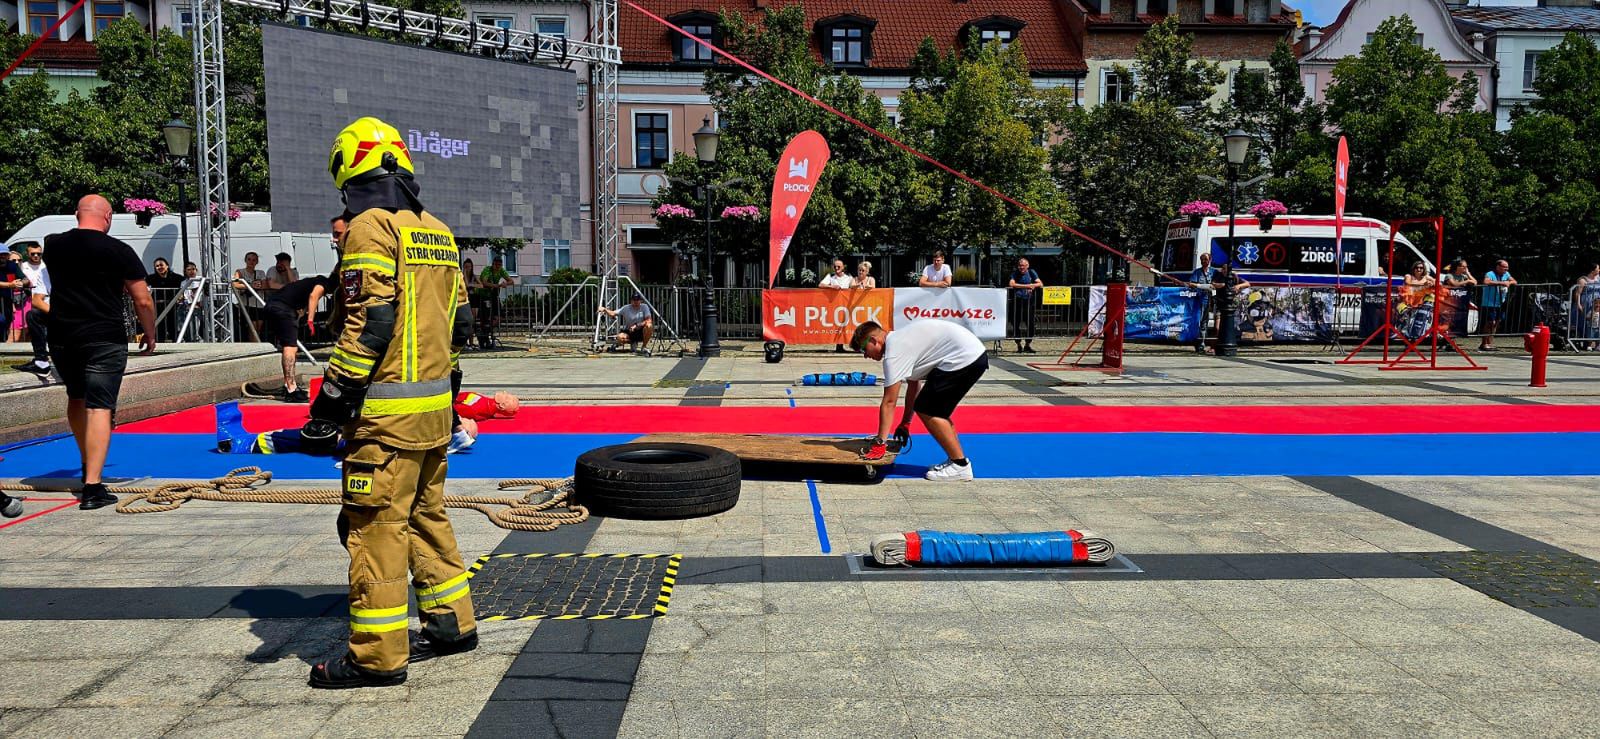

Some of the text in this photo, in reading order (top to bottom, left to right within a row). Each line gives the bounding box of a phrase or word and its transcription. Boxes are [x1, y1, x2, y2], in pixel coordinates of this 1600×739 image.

[408, 129, 471, 158] Dräger
[783, 183, 810, 193] PŁOCK
[1301, 251, 1356, 263] ZDROIE
[805, 306, 883, 328] PŁOCK
[350, 478, 368, 490] OSP
